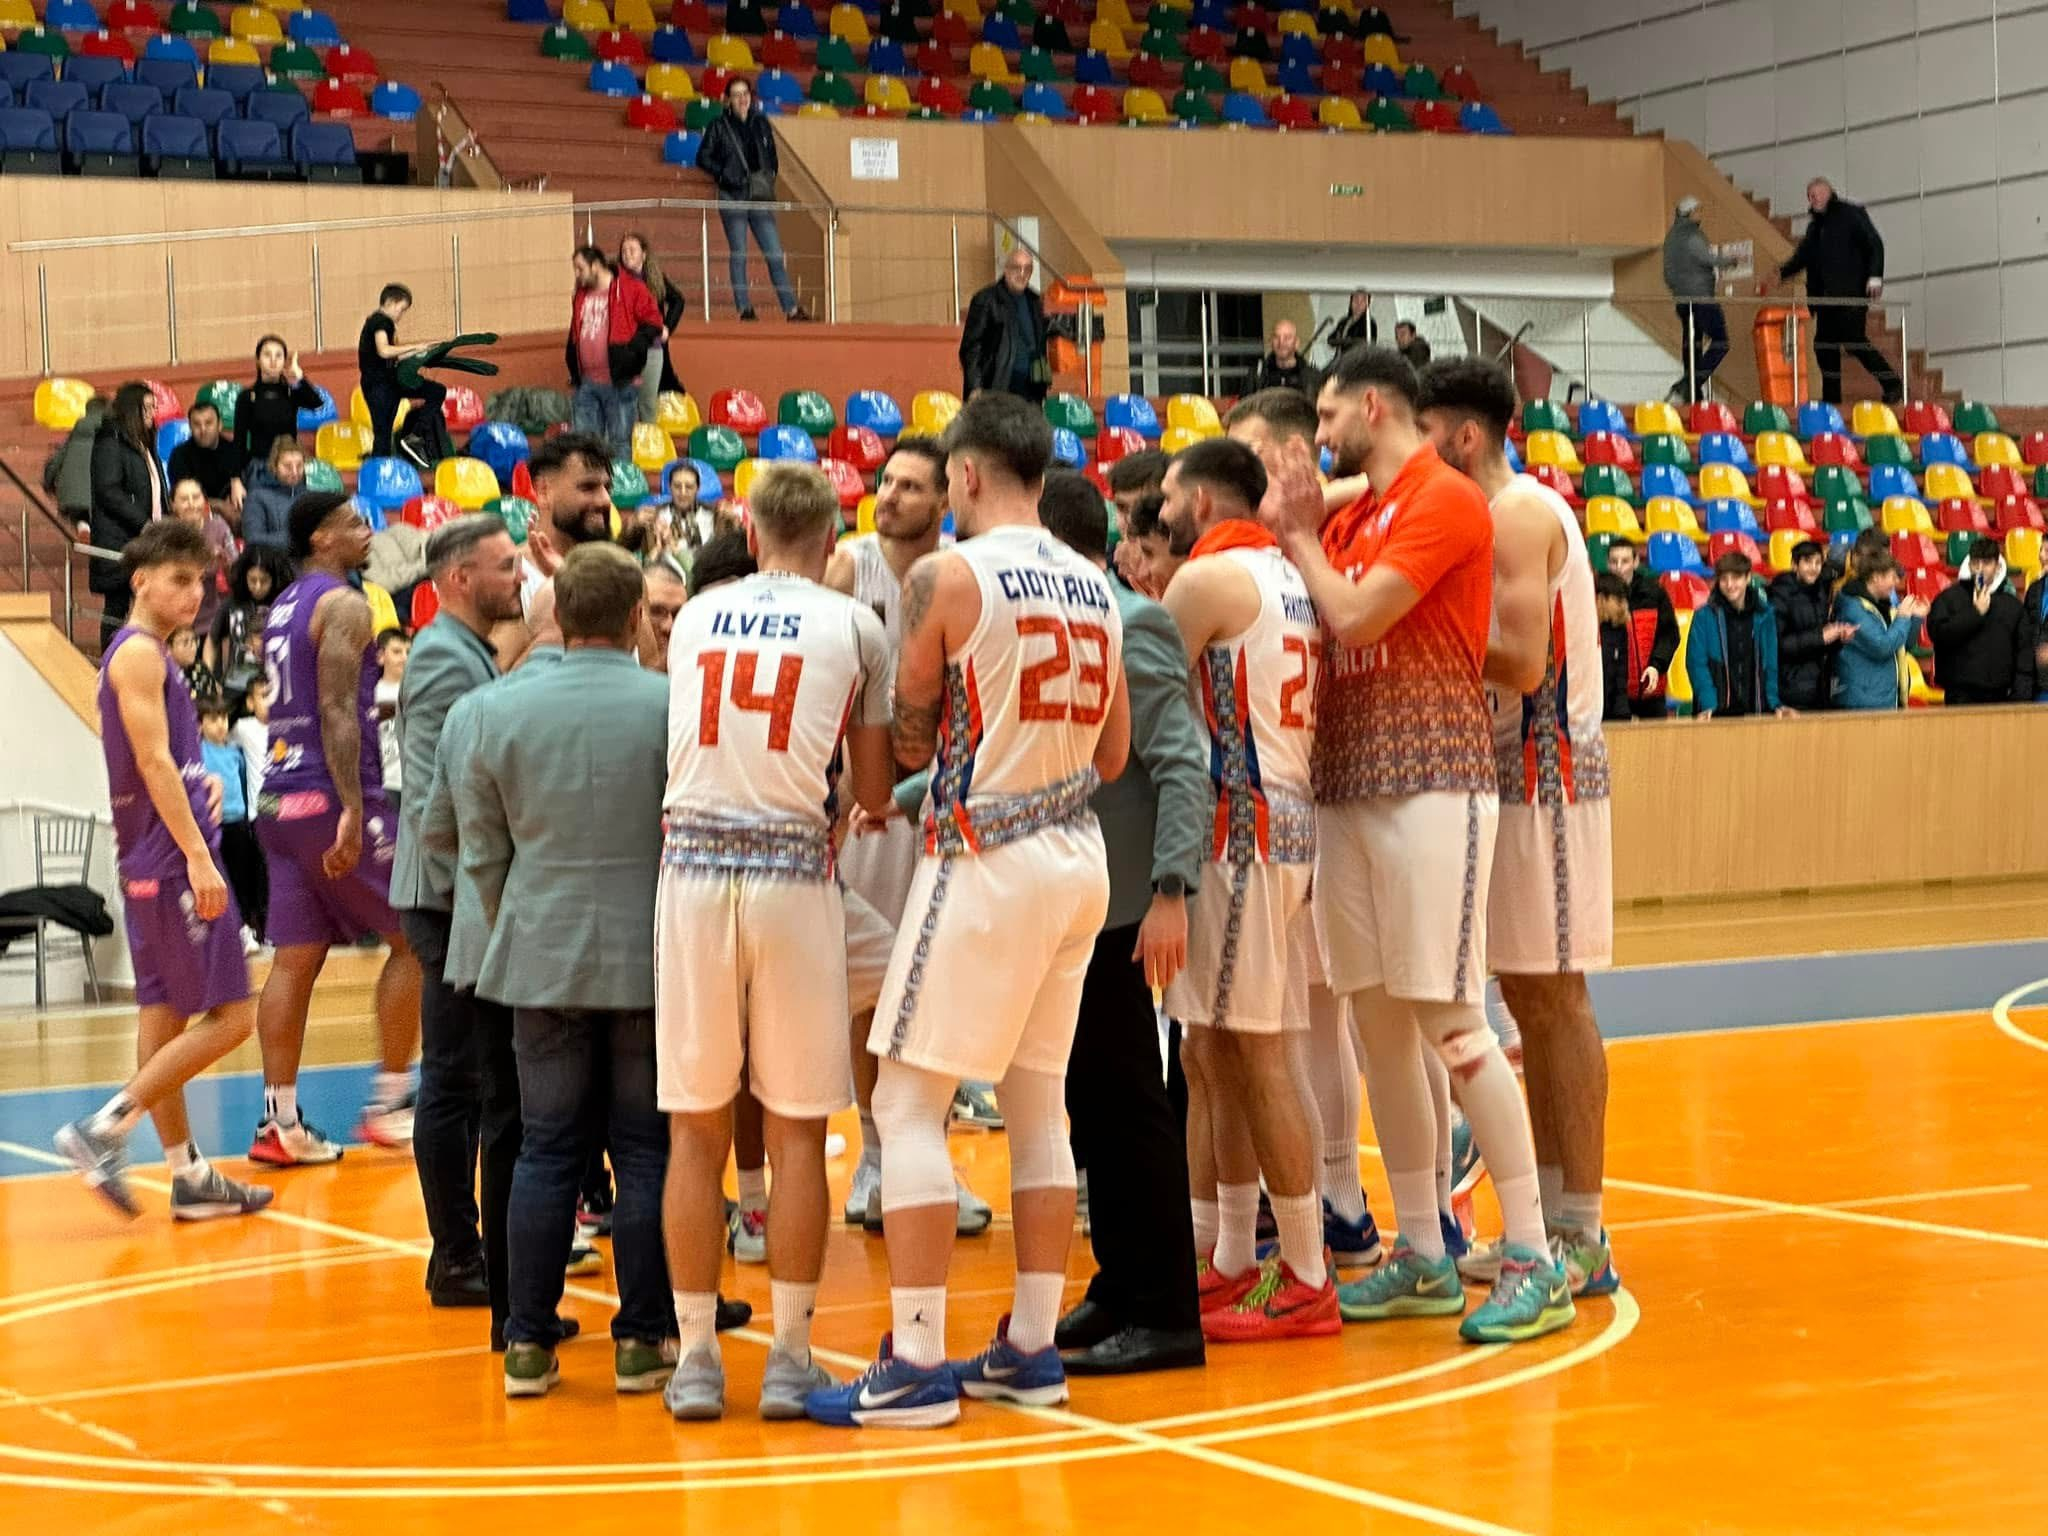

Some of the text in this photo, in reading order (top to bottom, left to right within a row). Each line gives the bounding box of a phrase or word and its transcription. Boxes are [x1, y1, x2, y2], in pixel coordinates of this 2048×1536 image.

[711, 610, 802, 640] ILVES
[1016, 615, 1109, 725] 23
[696, 648, 804, 753] 14
